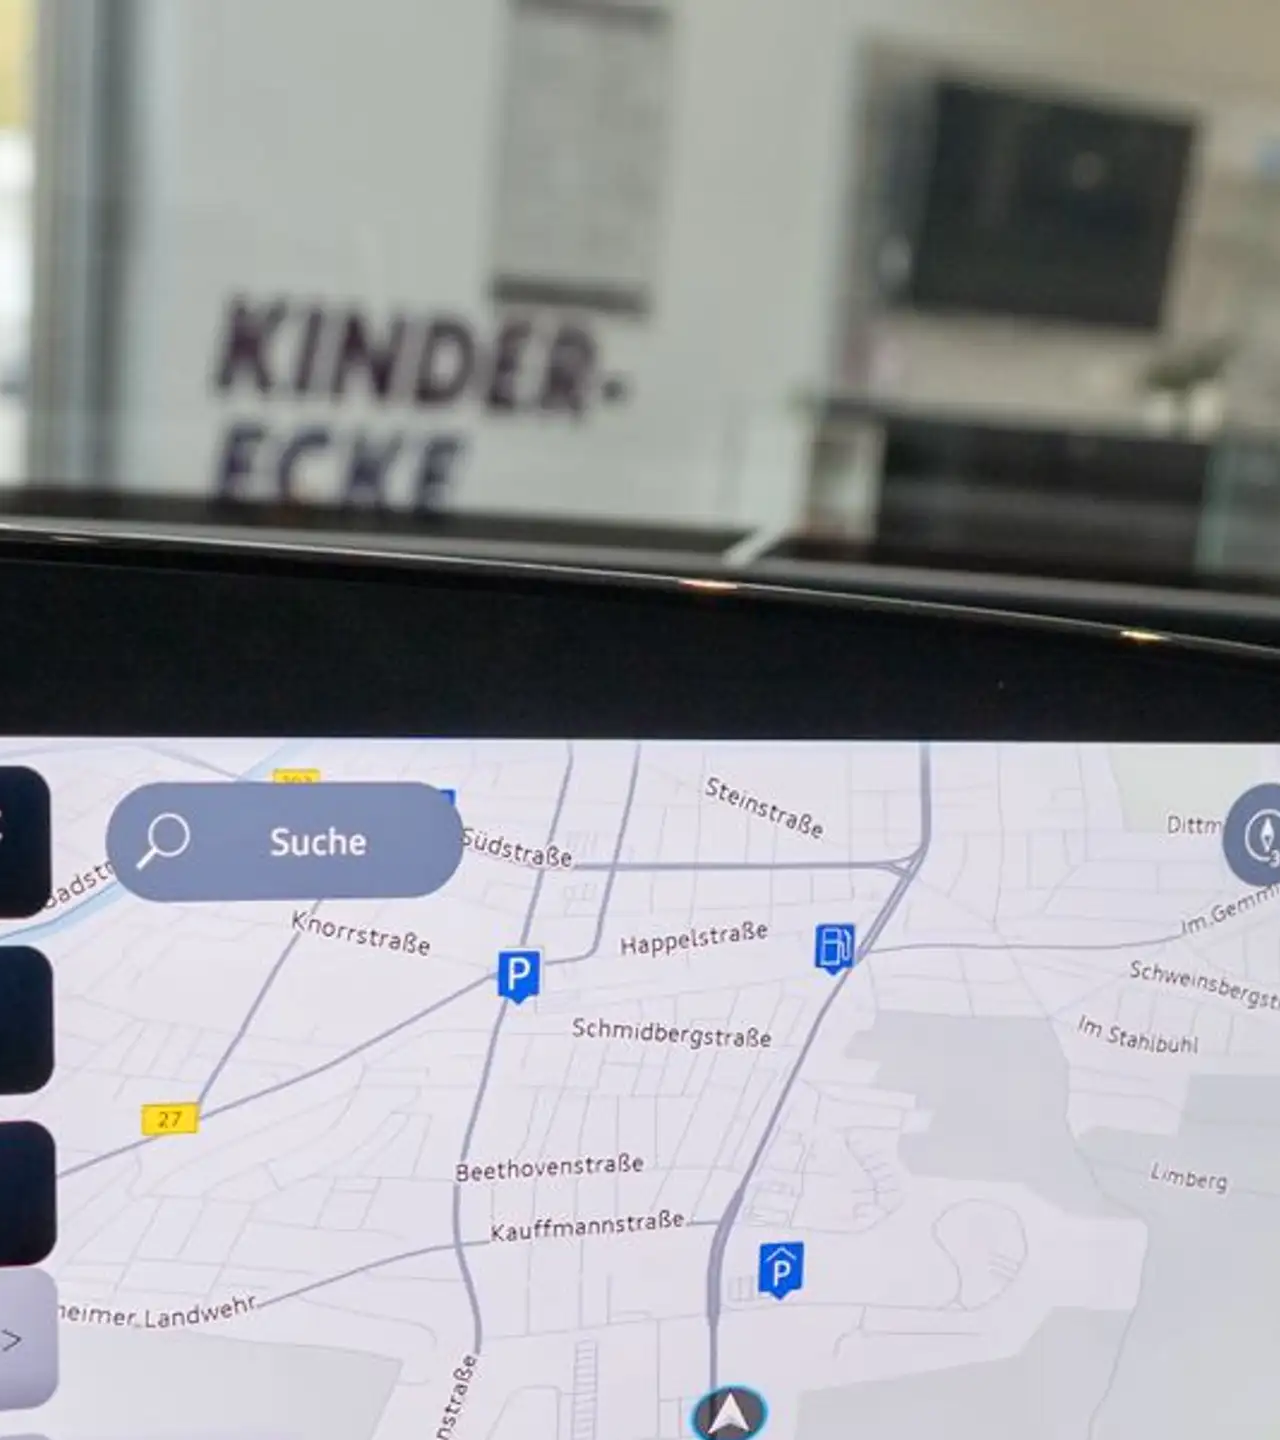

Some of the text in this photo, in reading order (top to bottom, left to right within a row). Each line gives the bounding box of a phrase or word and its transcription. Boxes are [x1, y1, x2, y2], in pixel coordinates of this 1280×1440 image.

[216, 293, 629, 422] KINDER-
[217, 421, 470, 511] ECKE
[705, 776, 824, 840] Steinstraße
[270, 826, 368, 857] Suche
[291, 908, 431, 957] Knorrstraße
[620, 921, 768, 958] Happelstraße
[572, 1017, 772, 1050] Schmidbergstraße
[1076, 1013, 1103, 1038] Im
[157, 1110, 183, 1129] 27
[456, 1152, 644, 1183] Beethovenstraße
[1150, 1162, 1228, 1195] Limberg
[490, 1209, 685, 1243] Kauffmannstraße
[145, 1295, 256, 1329] Landwehr
